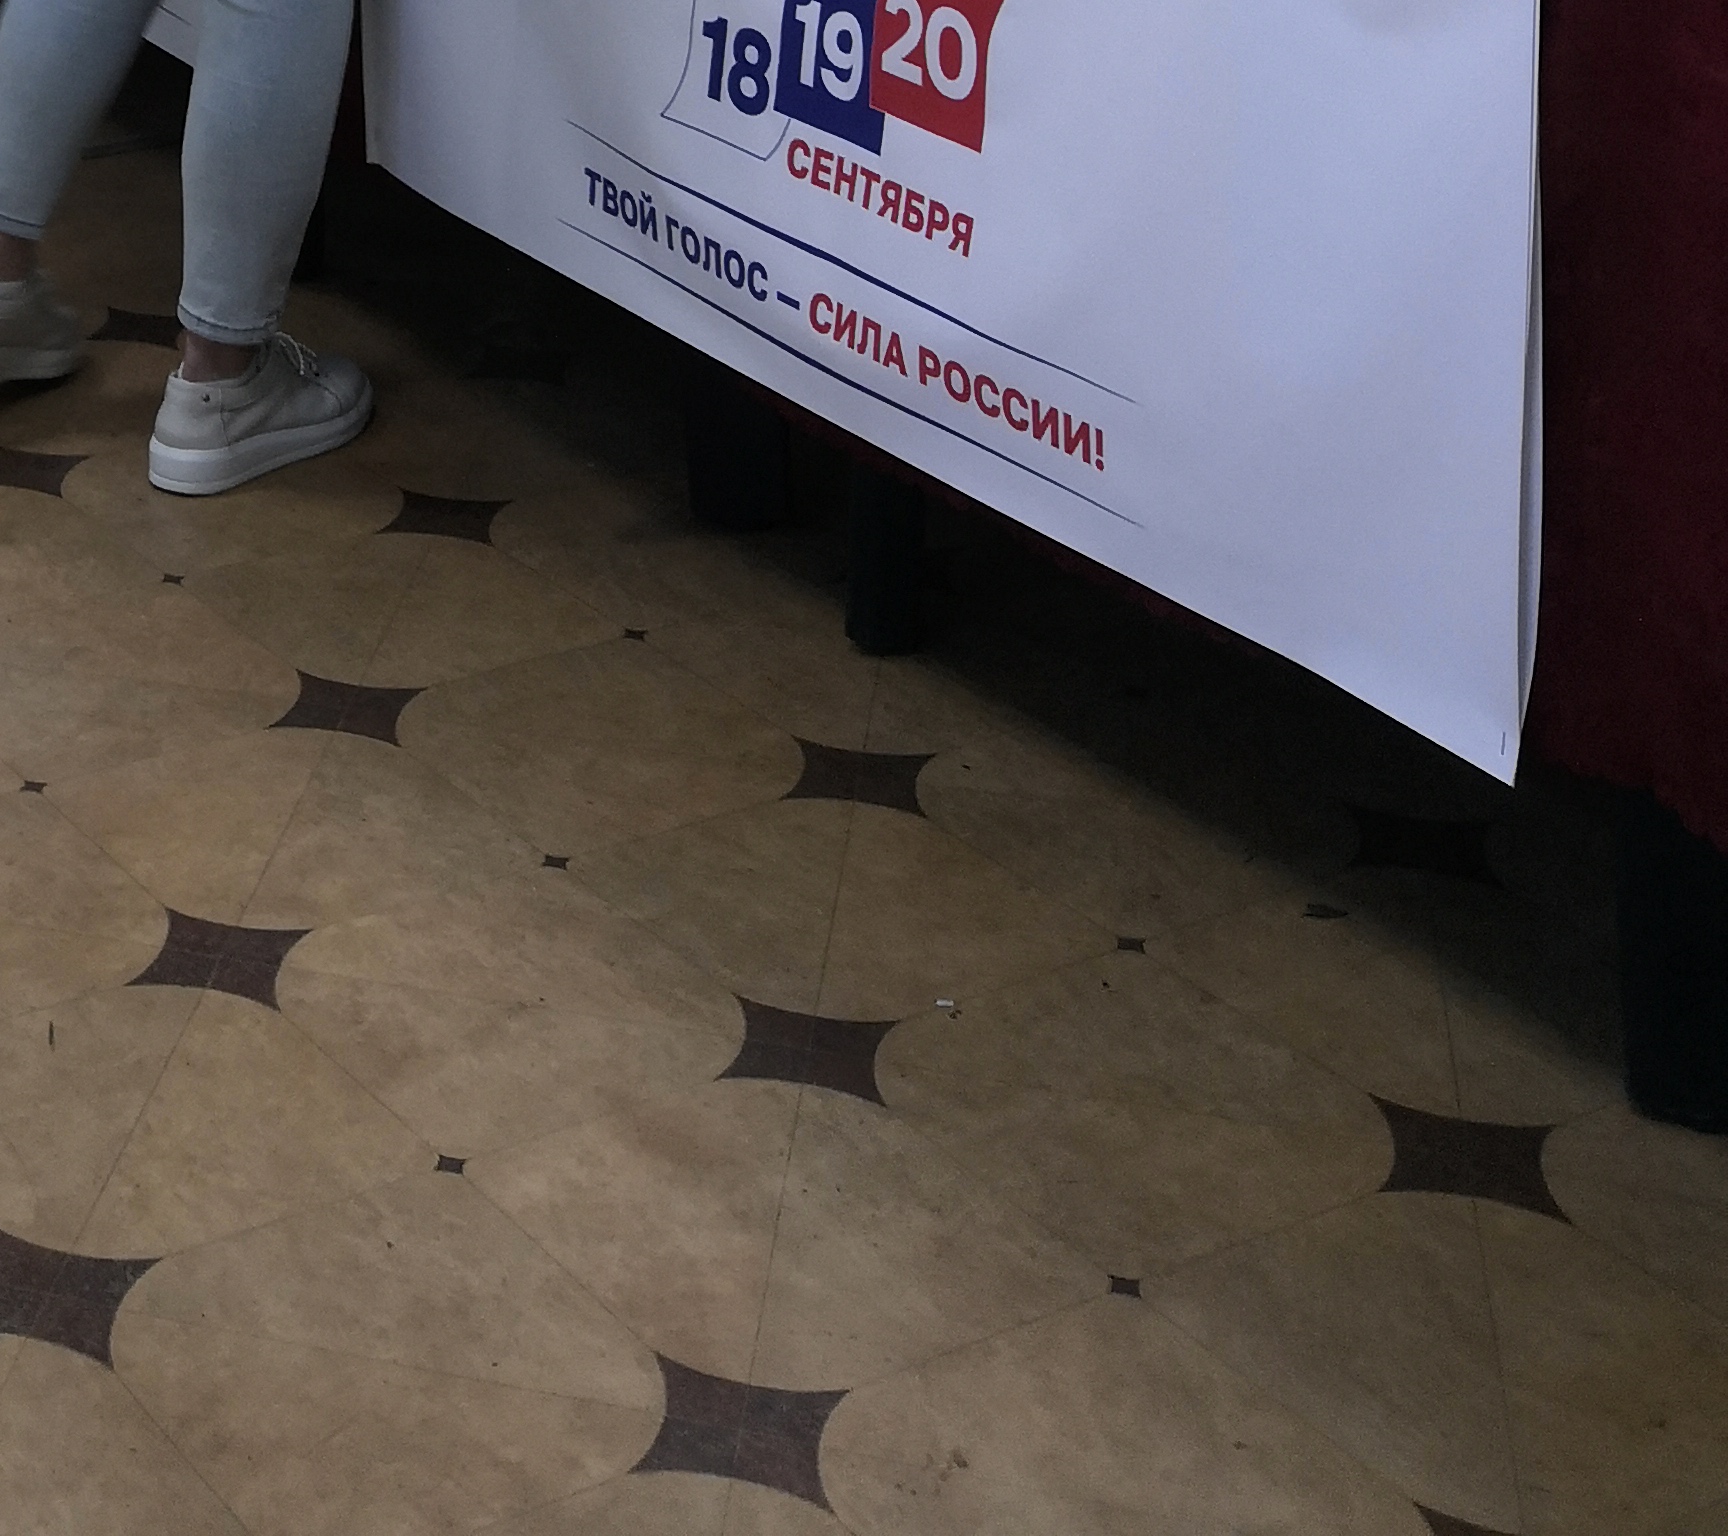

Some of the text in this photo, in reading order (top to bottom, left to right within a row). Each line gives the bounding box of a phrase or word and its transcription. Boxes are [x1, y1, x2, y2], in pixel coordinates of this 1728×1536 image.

[702, 16, 772, 116] 18
[795, 0, 864, 102] 19
[787, 138, 974, 258] СЕНТЯБРЯ
[584, 167, 658, 240] ТВОЙ
[665, 214, 769, 303] ГОЛОС
[809, 292, 908, 376] СИЛА
[918, 344, 1105, 471] РОССИИ!
